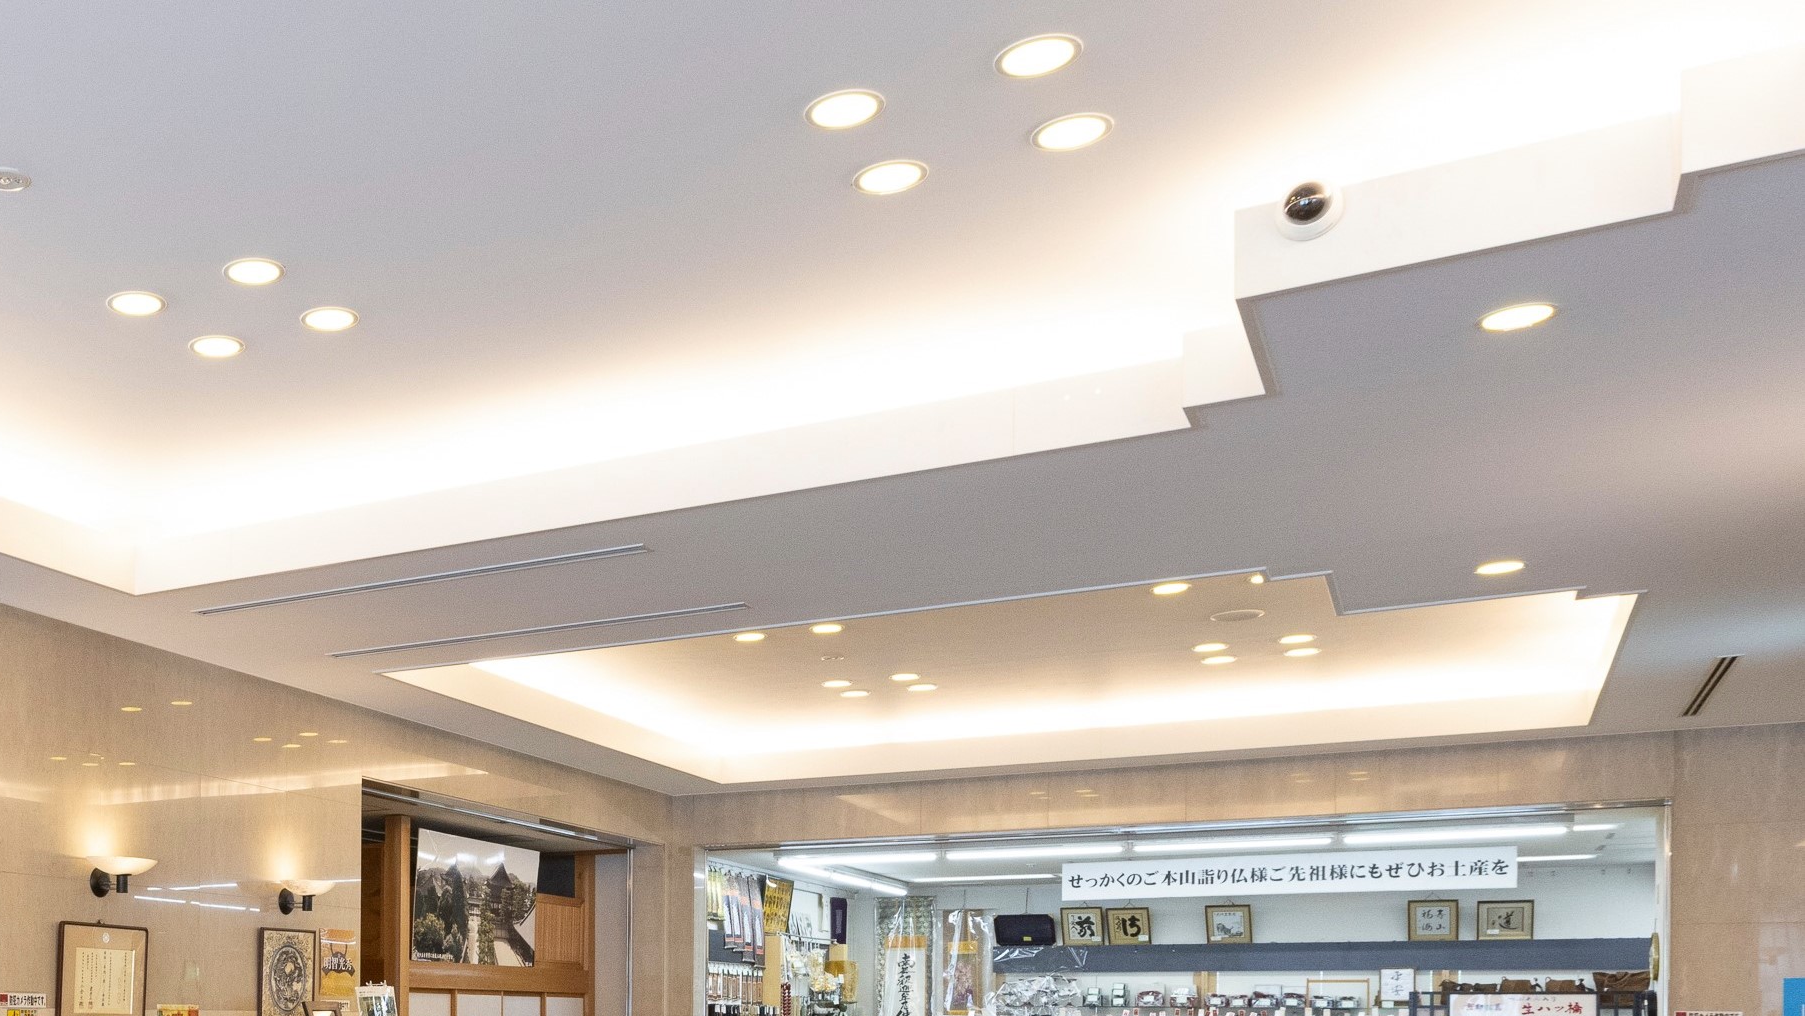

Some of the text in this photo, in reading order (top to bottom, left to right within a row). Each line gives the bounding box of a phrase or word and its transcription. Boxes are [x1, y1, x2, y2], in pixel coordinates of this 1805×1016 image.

[1068, 857, 1510, 889] せっかくのご本山詣り仏様ご先祖様にもぜひお土産を
[323, 956, 353, 971] 明智光秀
